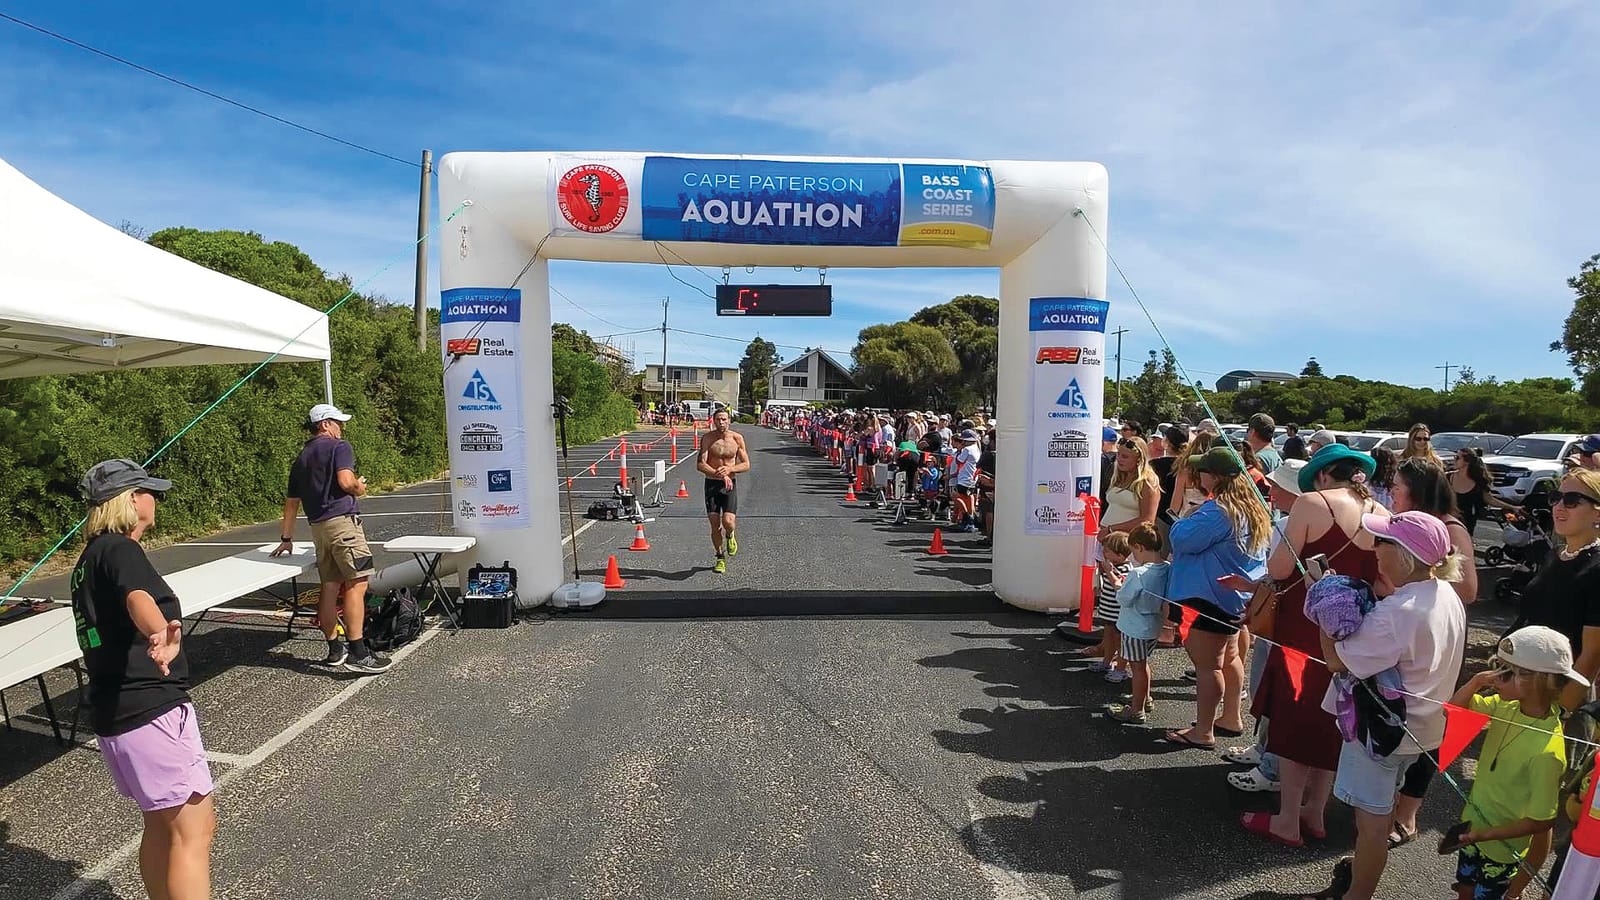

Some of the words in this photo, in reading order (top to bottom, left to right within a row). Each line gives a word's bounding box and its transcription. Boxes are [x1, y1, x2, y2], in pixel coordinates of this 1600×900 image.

[566, 166, 584, 180] CAPE
[585, 165, 621, 182] PATERSON
[683, 173, 741, 189] CAPE
[749, 175, 863, 192] PATERSON
[922, 175, 960, 187] BASS
[922, 188, 973, 201] COAST
[681, 199, 863, 228] AQUATHON
[922, 203, 973, 217] SERIES
[560, 203, 574, 221] SURF
[572, 219, 588, 230] LIFE
[588, 222, 614, 233] SAVING
[612, 206, 626, 225] CLUB
[918, 227, 956, 236] .com.au
[447, 305, 507, 316] AQUATHON
[1043, 304, 1065, 312] CAPE
[1042, 314, 1099, 325] AQUATHON
[483, 338, 505, 347] Real
[483, 348, 514, 356] Estate
[1082, 347, 1097, 356] Real
[1082, 357, 1101, 366] Estate
[461, 434, 503, 443] CONCRETING
[1048, 442, 1089, 450] CONCRETING
